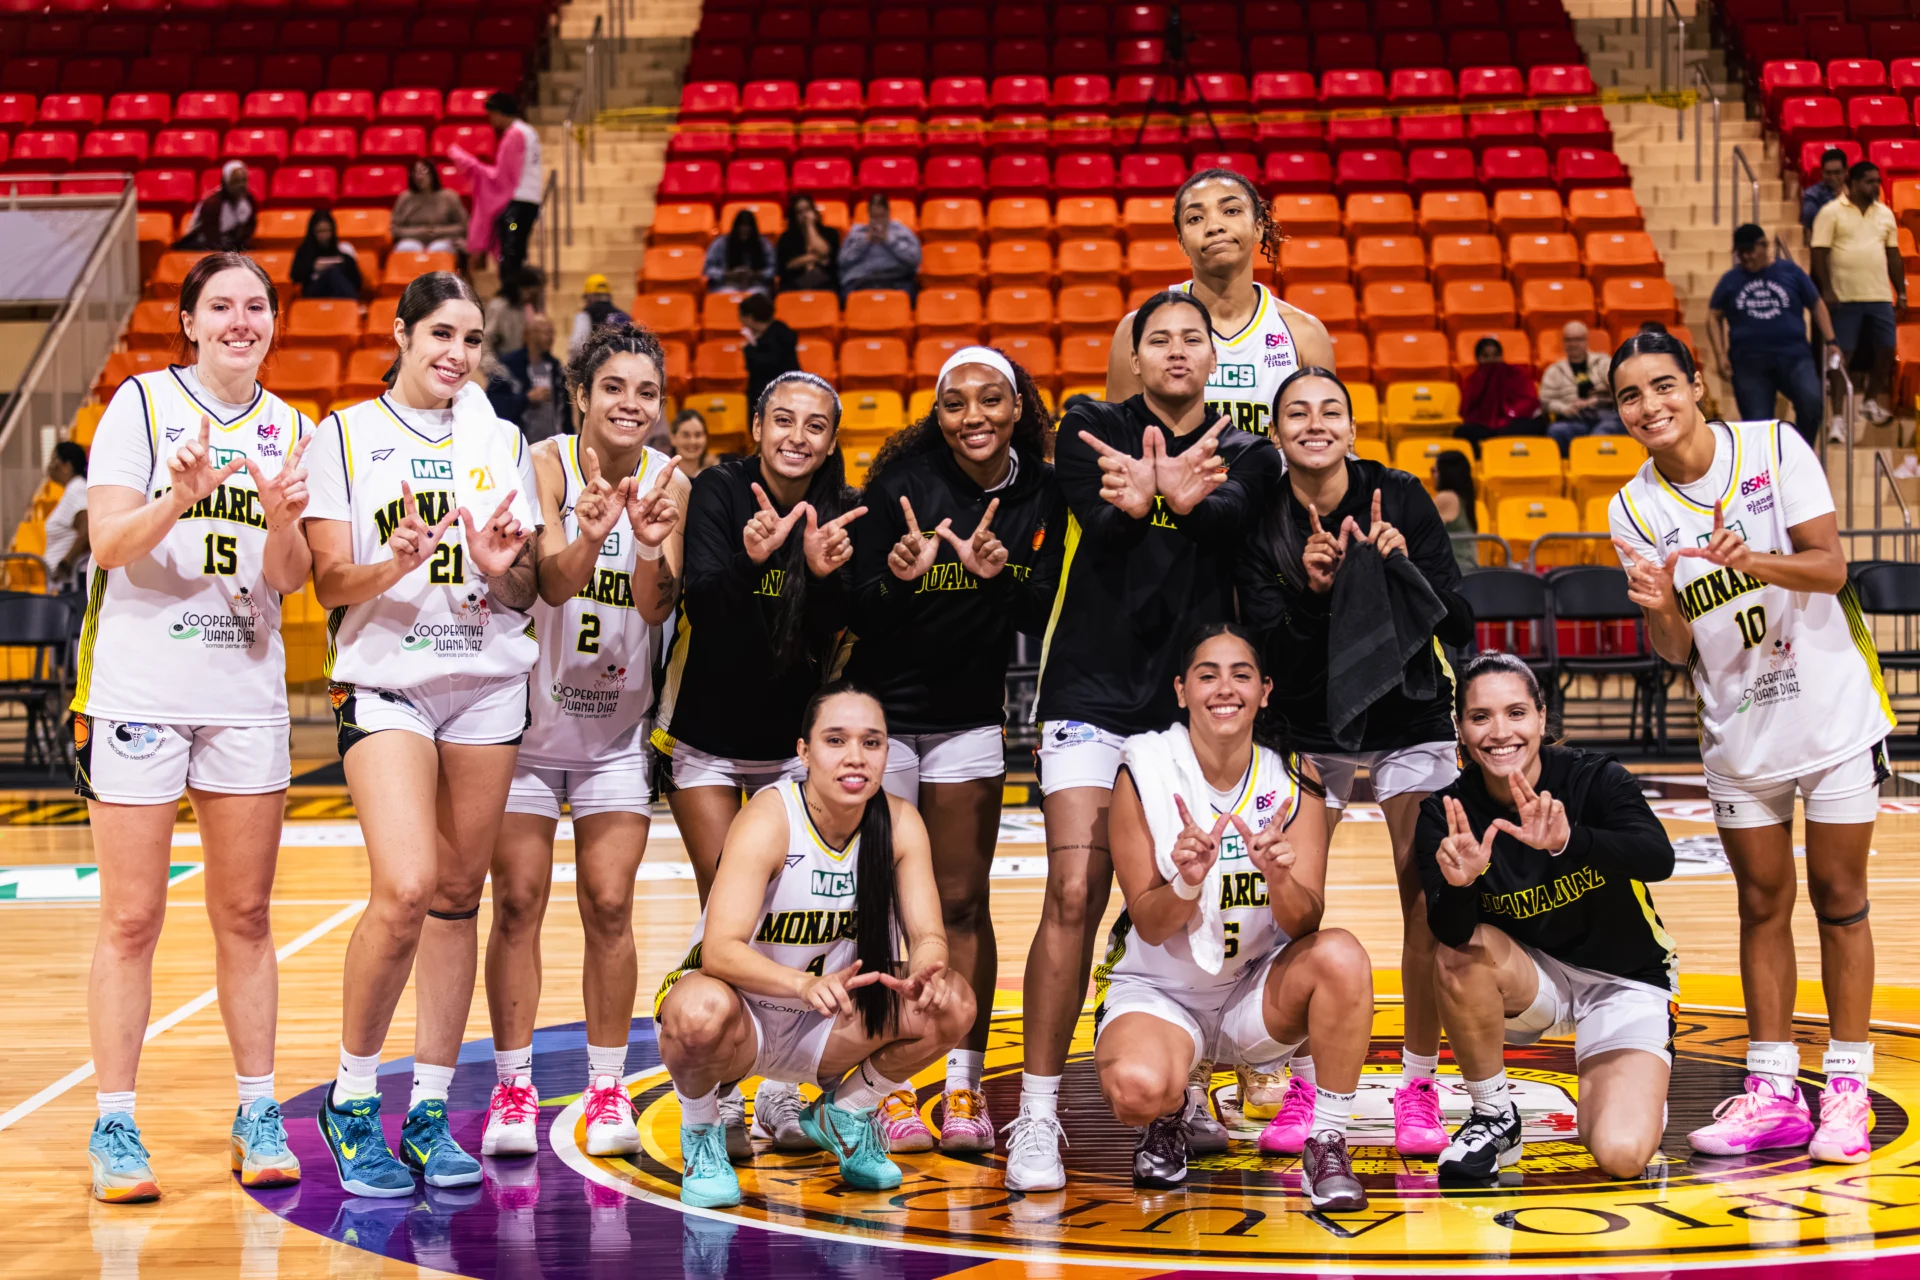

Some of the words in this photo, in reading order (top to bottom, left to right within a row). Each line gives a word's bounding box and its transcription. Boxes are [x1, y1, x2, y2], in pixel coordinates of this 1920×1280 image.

[411, 459, 454, 480] MC
[469, 465, 496, 492] 21
[203, 533, 238, 575] 15
[430, 543, 464, 586] 21
[182, 611, 255, 628] COOPERATIVA
[413, 622, 484, 637] COOPERATIVA
[1735, 605, 1768, 650] 10
[201, 627, 234, 642] JUANA
[237, 627, 256, 643] DÍAZ
[576, 612, 601, 654] 2
[433, 637, 464, 651] JUANA
[562, 698, 595, 713] JUANA
[597, 700, 618, 714] DÍAZ
